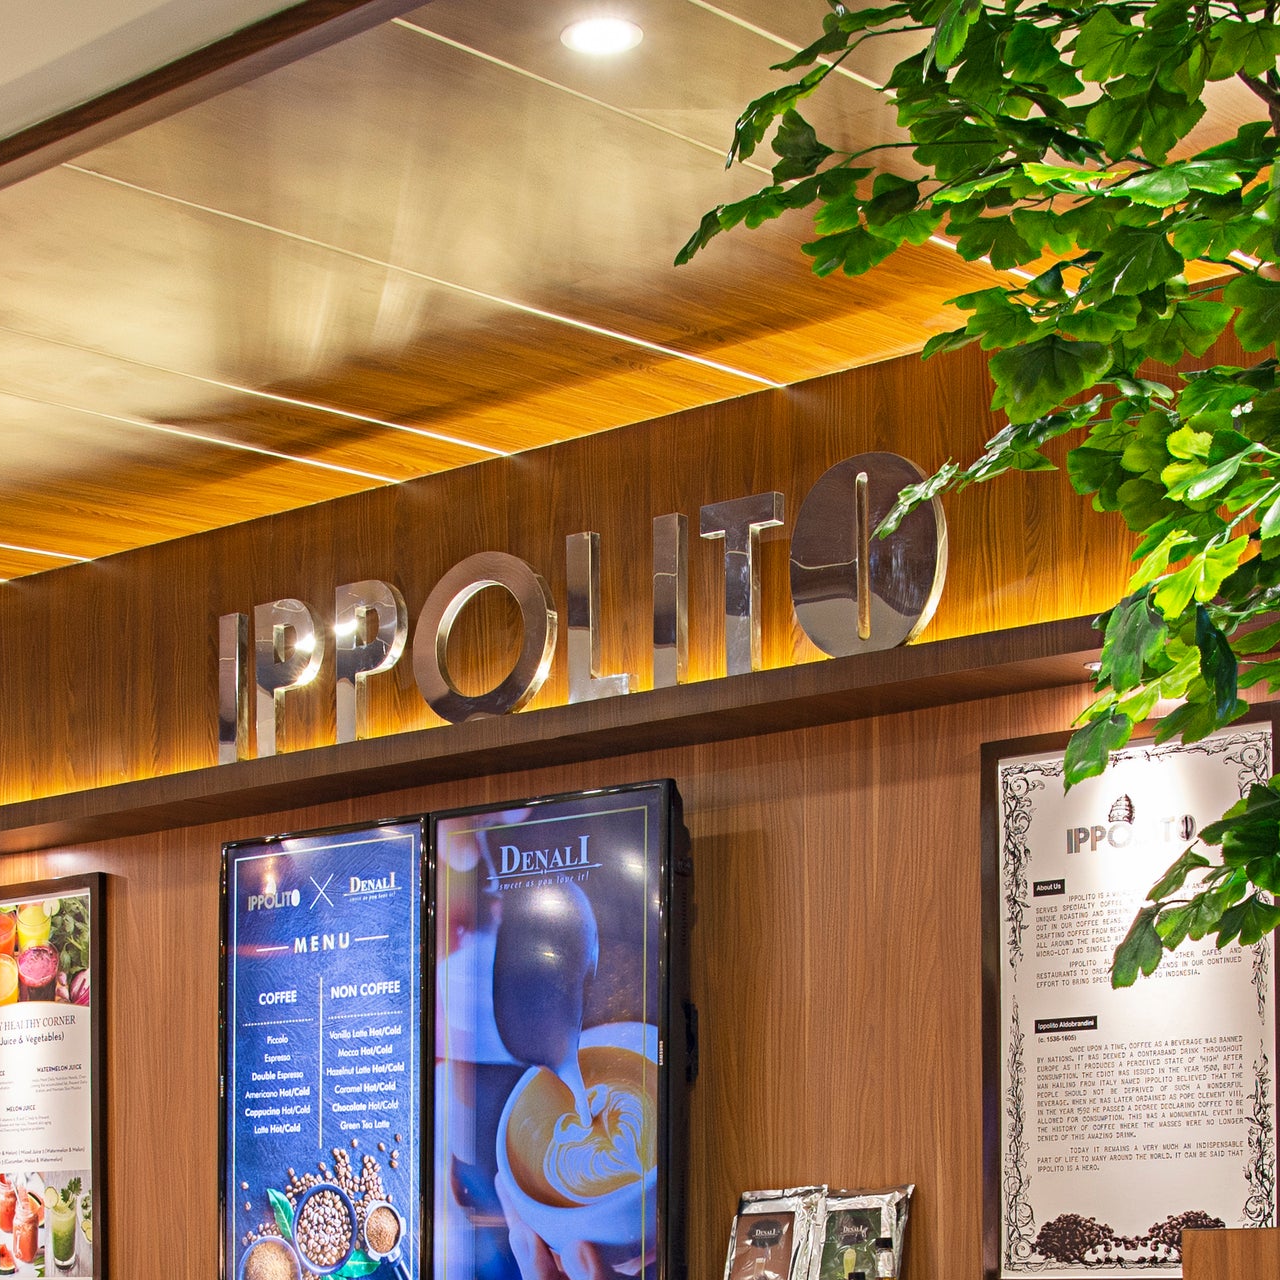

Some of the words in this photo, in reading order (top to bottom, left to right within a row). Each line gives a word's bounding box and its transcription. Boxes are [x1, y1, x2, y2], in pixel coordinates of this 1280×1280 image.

[219, 451, 947, 763] IPPOLITO
[499, 835, 590, 874] DENALI
[499, 881, 522, 891] sweet
[537, 877, 553, 889] you
[557, 875, 574, 884] love
[578, 870, 589, 881] it!
[1036, 883, 1053, 891] About
[248, 889, 301, 911] IPPOLITO
[349, 872, 396, 893] DENALI
[294, 932, 350, 953] MENU
[330, 984, 357, 999] NON
[360, 980, 401, 996] COFFEE
[258, 990, 297, 1006] COFFEE
[42, 1015, 76, 1027] CORNER
[1059, 1019, 1094, 1028] Aldobrandini
[0, 1037, 16, 1046] Juice
[26, 1031, 65, 1045] Vegetables)
[330, 1029, 351, 1039] Vanilla
[352, 1029, 368, 1038] Latte
[369, 1025, 401, 1037] Hot/Cold
[267, 1034, 289, 1044] Piccolo
[338, 1049, 359, 1057] Mocca
[360, 1044, 392, 1056] Hot/Cold
[264, 1053, 291, 1064] Espresso
[37, 1065, 68, 1073] WATERMELON
[326, 1066, 355, 1076] Hazelnut
[356, 1066, 370, 1075] Latte
[372, 1061, 405, 1073] Hot/Cold
[252, 1071, 276, 1081] Double
[277, 1071, 304, 1080] Espresso
[245, 1090, 278, 1099] Americano
[279, 1086, 310, 1097] Hot/Cold
[334, 1084, 362, 1094] Caramel
[364, 1081, 396, 1092] Hot/Cold
[245, 1107, 280, 1119] Cappucino
[281, 1104, 310, 1116] Hot/Cold
[332, 1102, 367, 1112] Chocolate
[368, 1099, 398, 1110] Hot/Cold
[254, 1126, 268, 1134] Latte
[270, 1123, 300, 1134] Hot/Cold
[340, 1121, 360, 1130] Green
[361, 1120, 373, 1129] Tea
[374, 1120, 390, 1129] Latte
